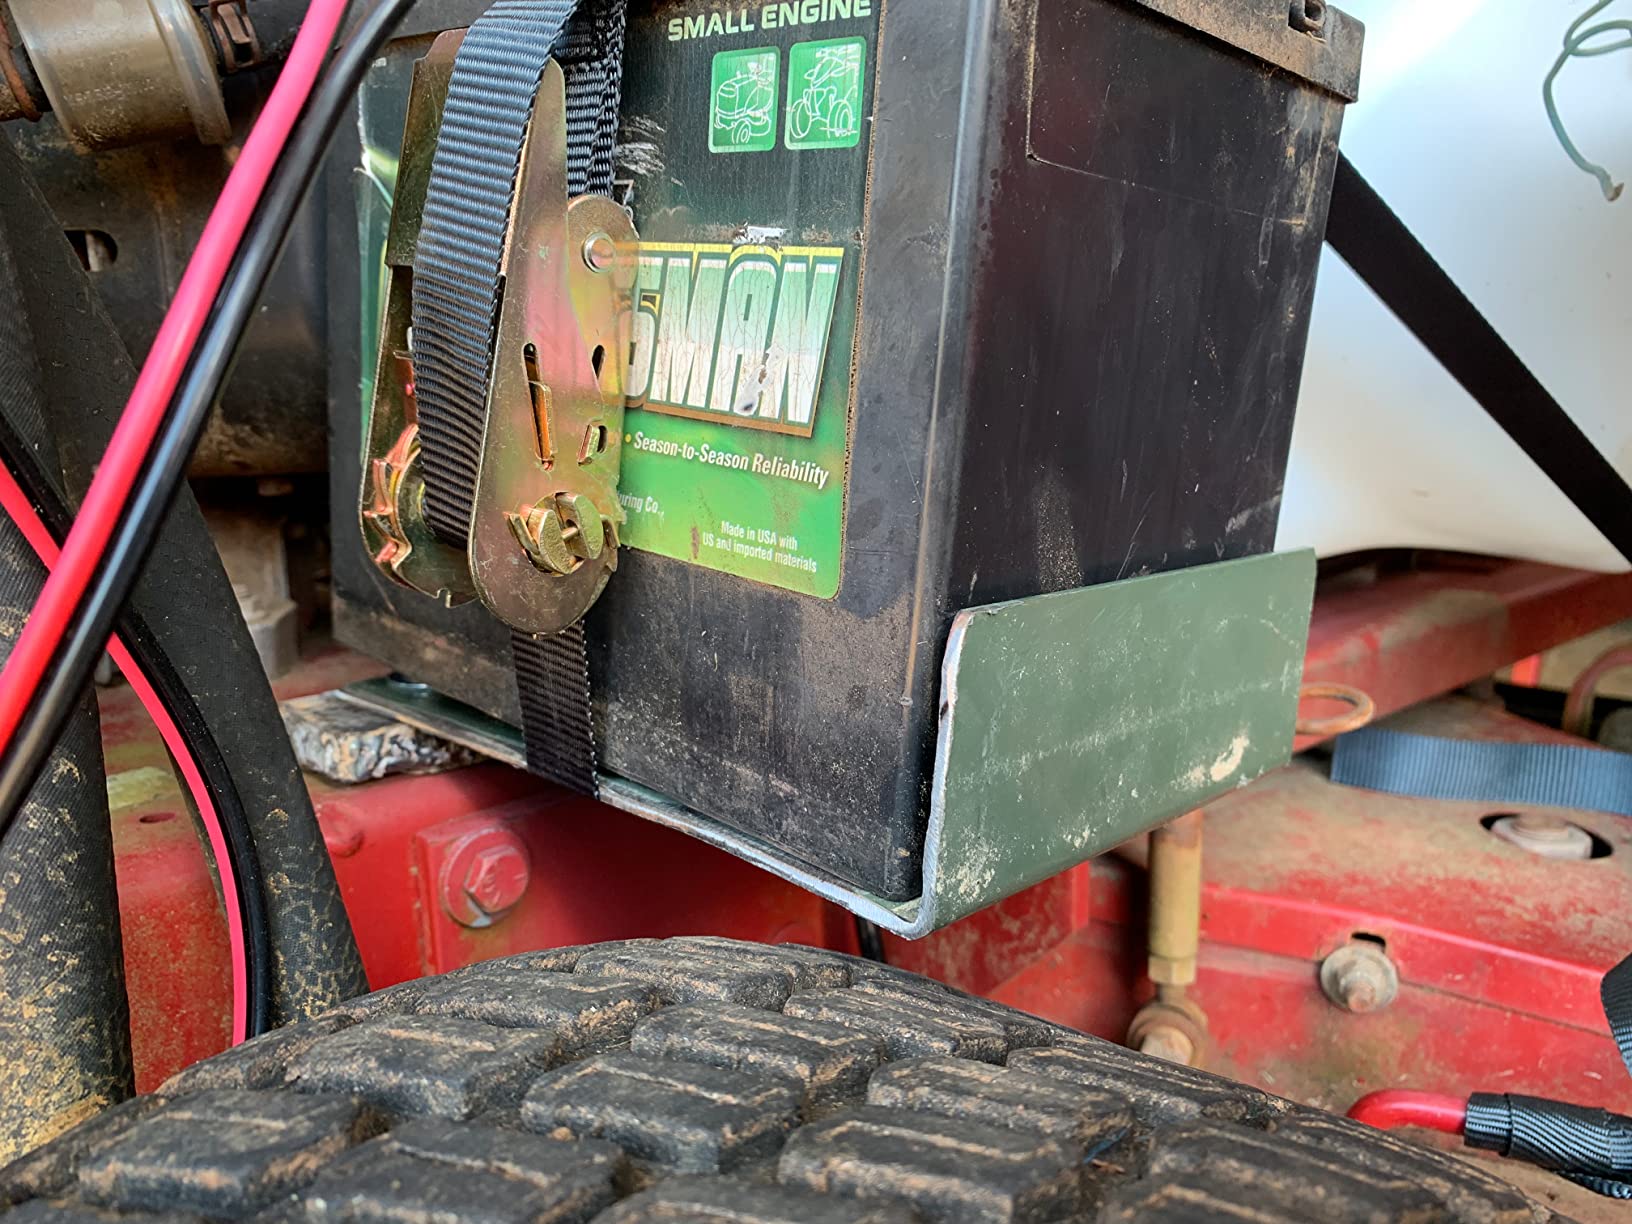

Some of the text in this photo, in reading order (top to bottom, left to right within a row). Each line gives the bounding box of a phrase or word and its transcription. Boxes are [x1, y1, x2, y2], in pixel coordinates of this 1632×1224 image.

[668, 0, 871, 41] SMALL ENGINE
[634, 431, 829, 489] Season-to-Season Reliability
[617, 491, 643, 513] uring
[703, 532, 817, 573] US and imported materials
[721, 521, 798, 551] Made in USA with
